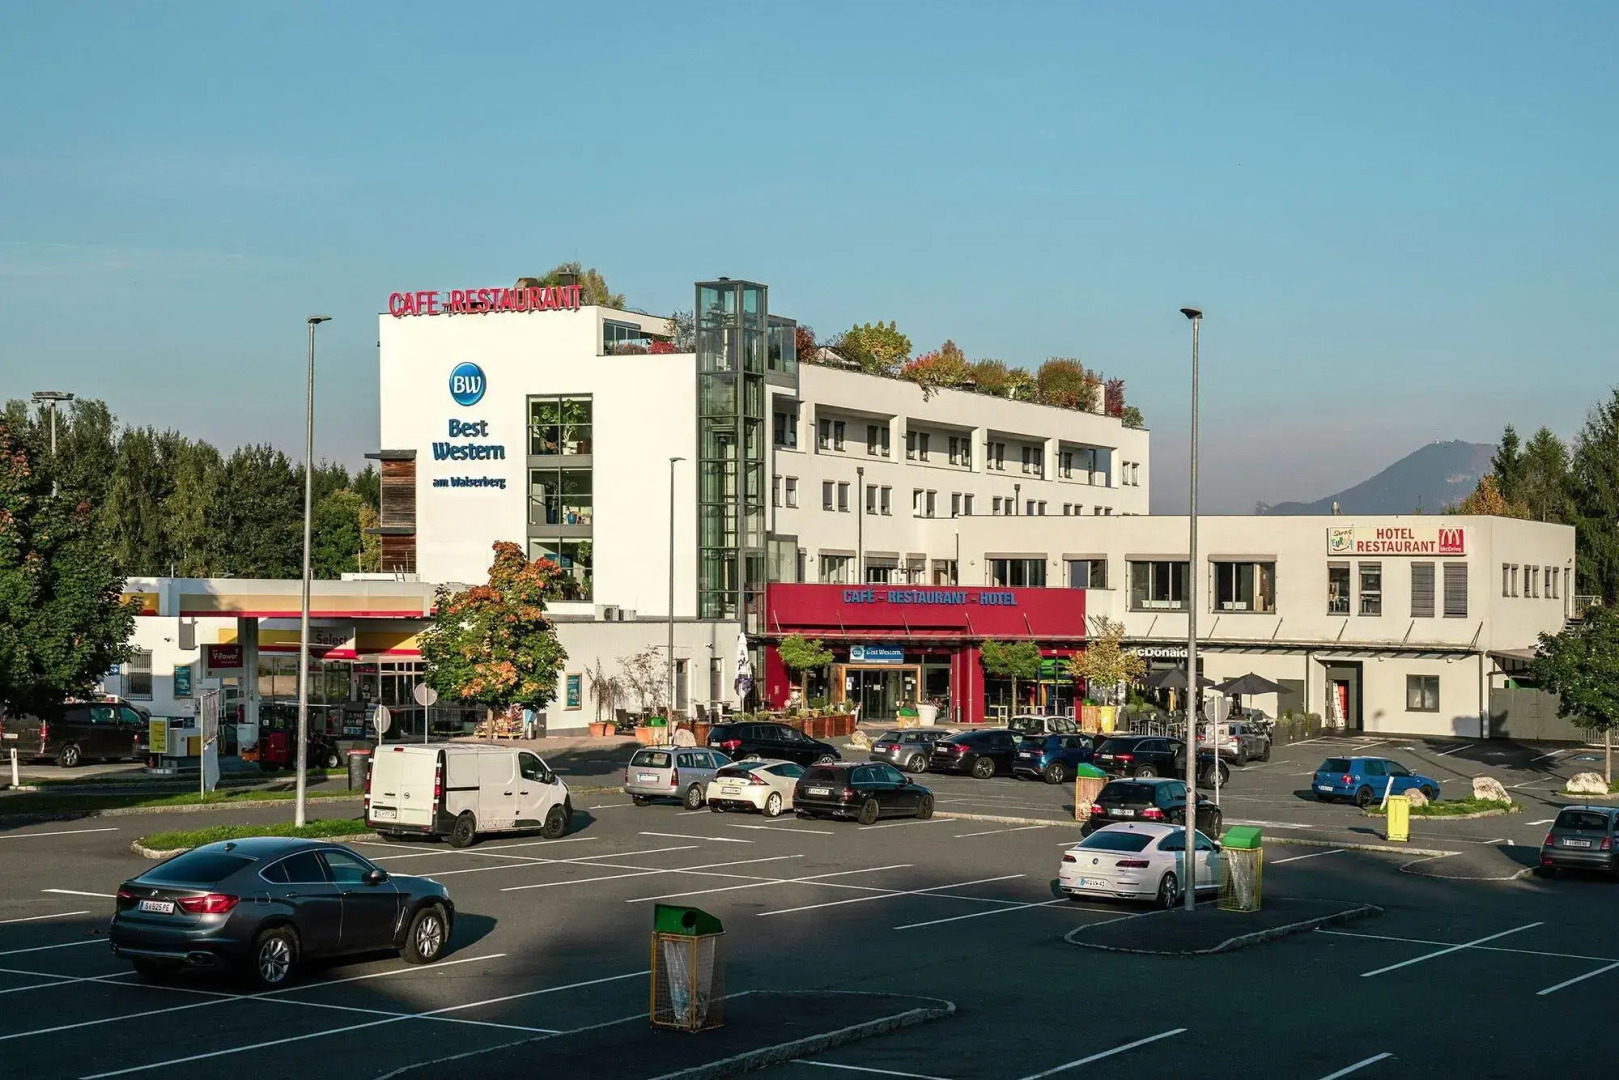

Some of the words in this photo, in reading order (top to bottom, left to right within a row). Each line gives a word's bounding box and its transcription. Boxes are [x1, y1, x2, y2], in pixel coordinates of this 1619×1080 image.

[453, 376, 481, 394] BW
[448, 418, 488, 437] Best
[432, 441, 505, 460] Western
[433, 478, 449, 487] am
[450, 476, 506, 489] Walserberg
[1376, 528, 1414, 540] HOTEL
[1357, 540, 1435, 552] RESTAURANT
[843, 587, 875, 604] CAFÉ
[888, 590, 967, 605] RESTAURANT
[980, 592, 1018, 605] HOTEL
[316, 633, 348, 645] Select
